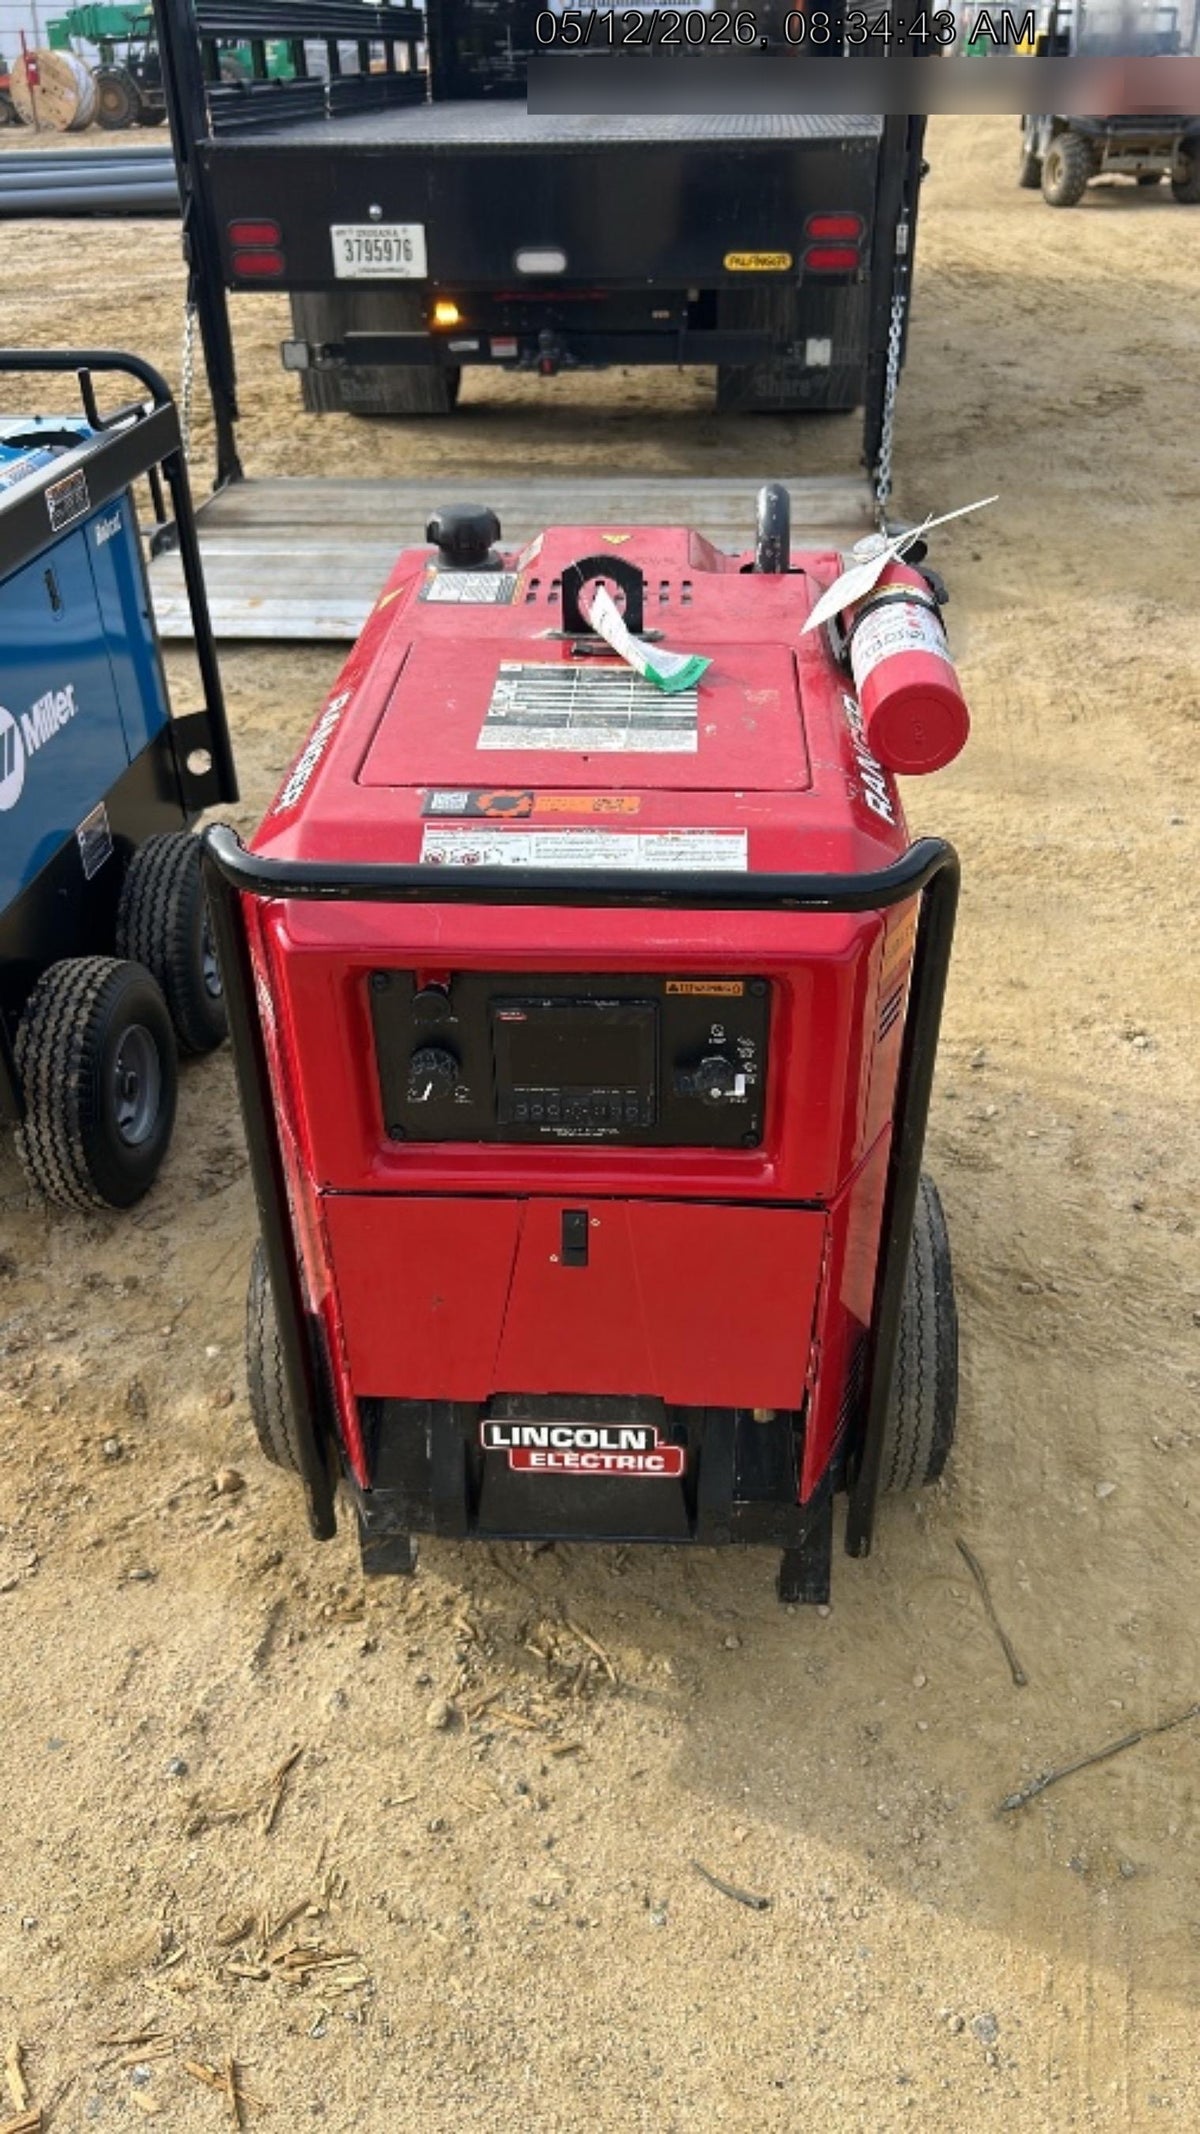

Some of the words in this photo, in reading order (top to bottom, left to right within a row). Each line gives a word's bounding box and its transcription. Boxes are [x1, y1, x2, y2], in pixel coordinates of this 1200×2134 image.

[344, 239, 413, 262] 3795976
[21, 684, 75, 757] Miller
[491, 1425, 647, 1450] LINCOLN
[529, 1452, 666, 1471] ELECTRIC
